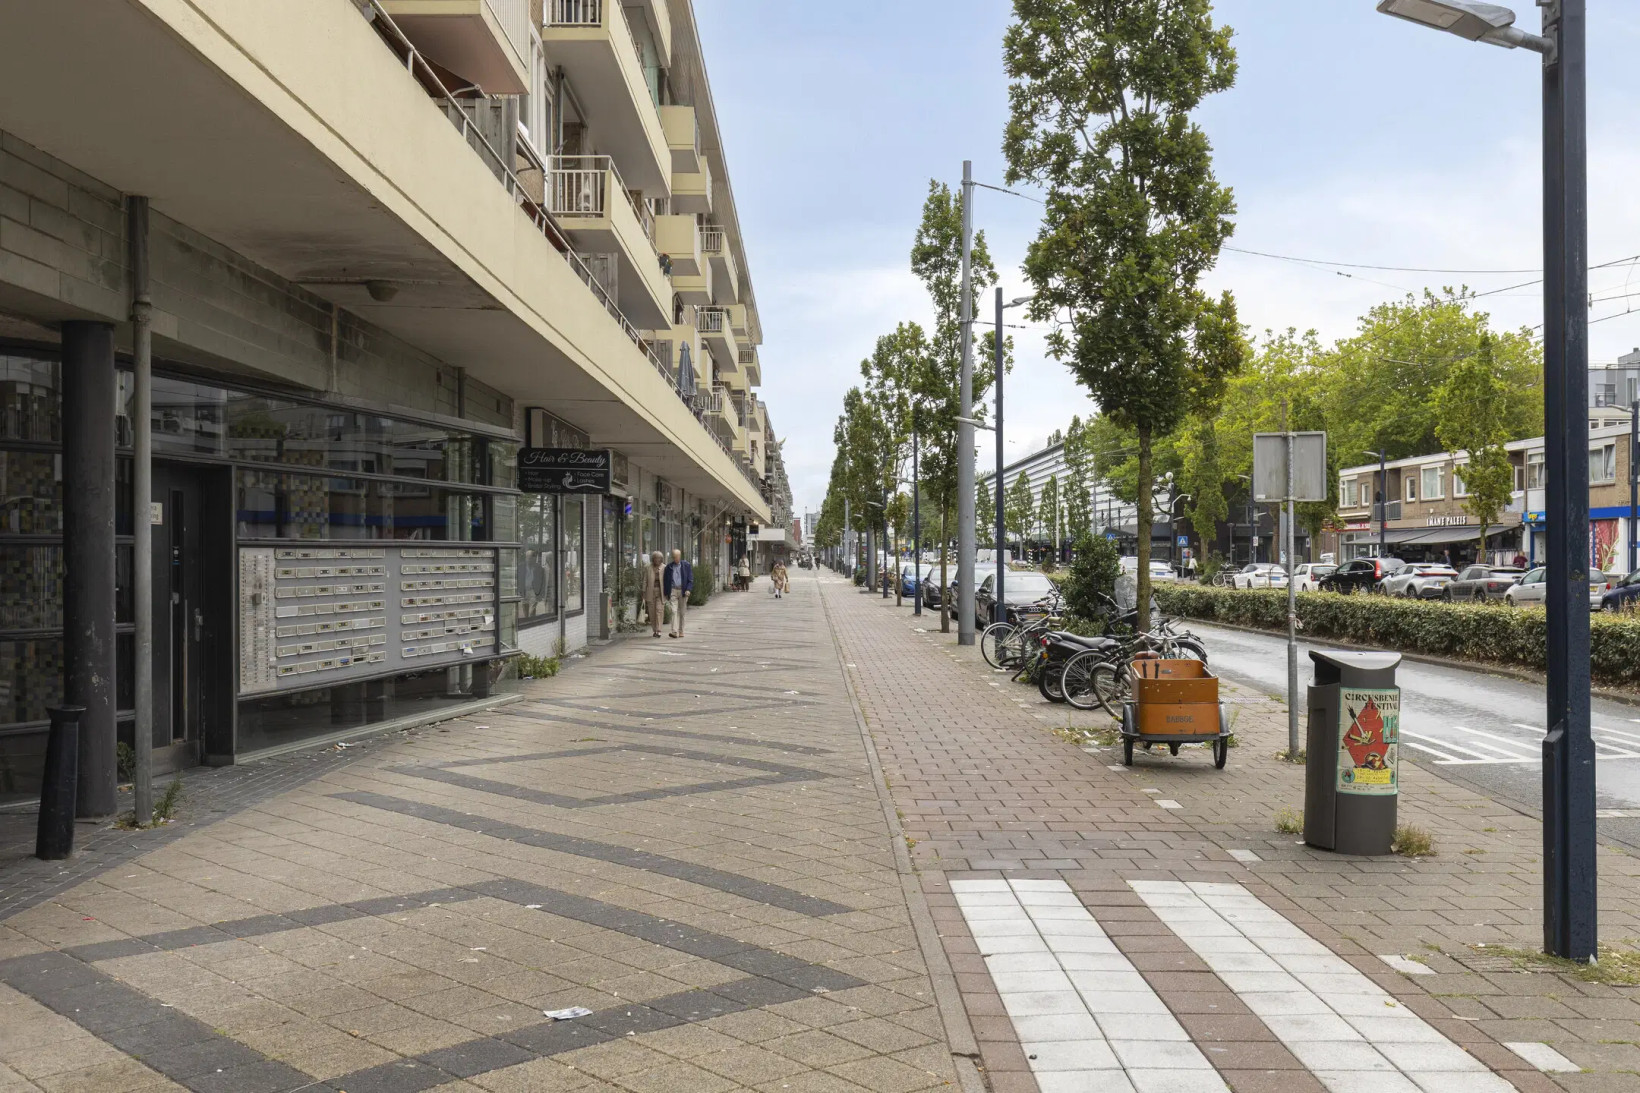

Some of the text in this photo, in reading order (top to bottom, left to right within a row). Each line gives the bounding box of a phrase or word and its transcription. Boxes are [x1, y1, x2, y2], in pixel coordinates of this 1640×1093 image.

[524, 452, 607, 468] Hair & Beauty
[1426, 515, 1467, 526] IMANE PALEIS
